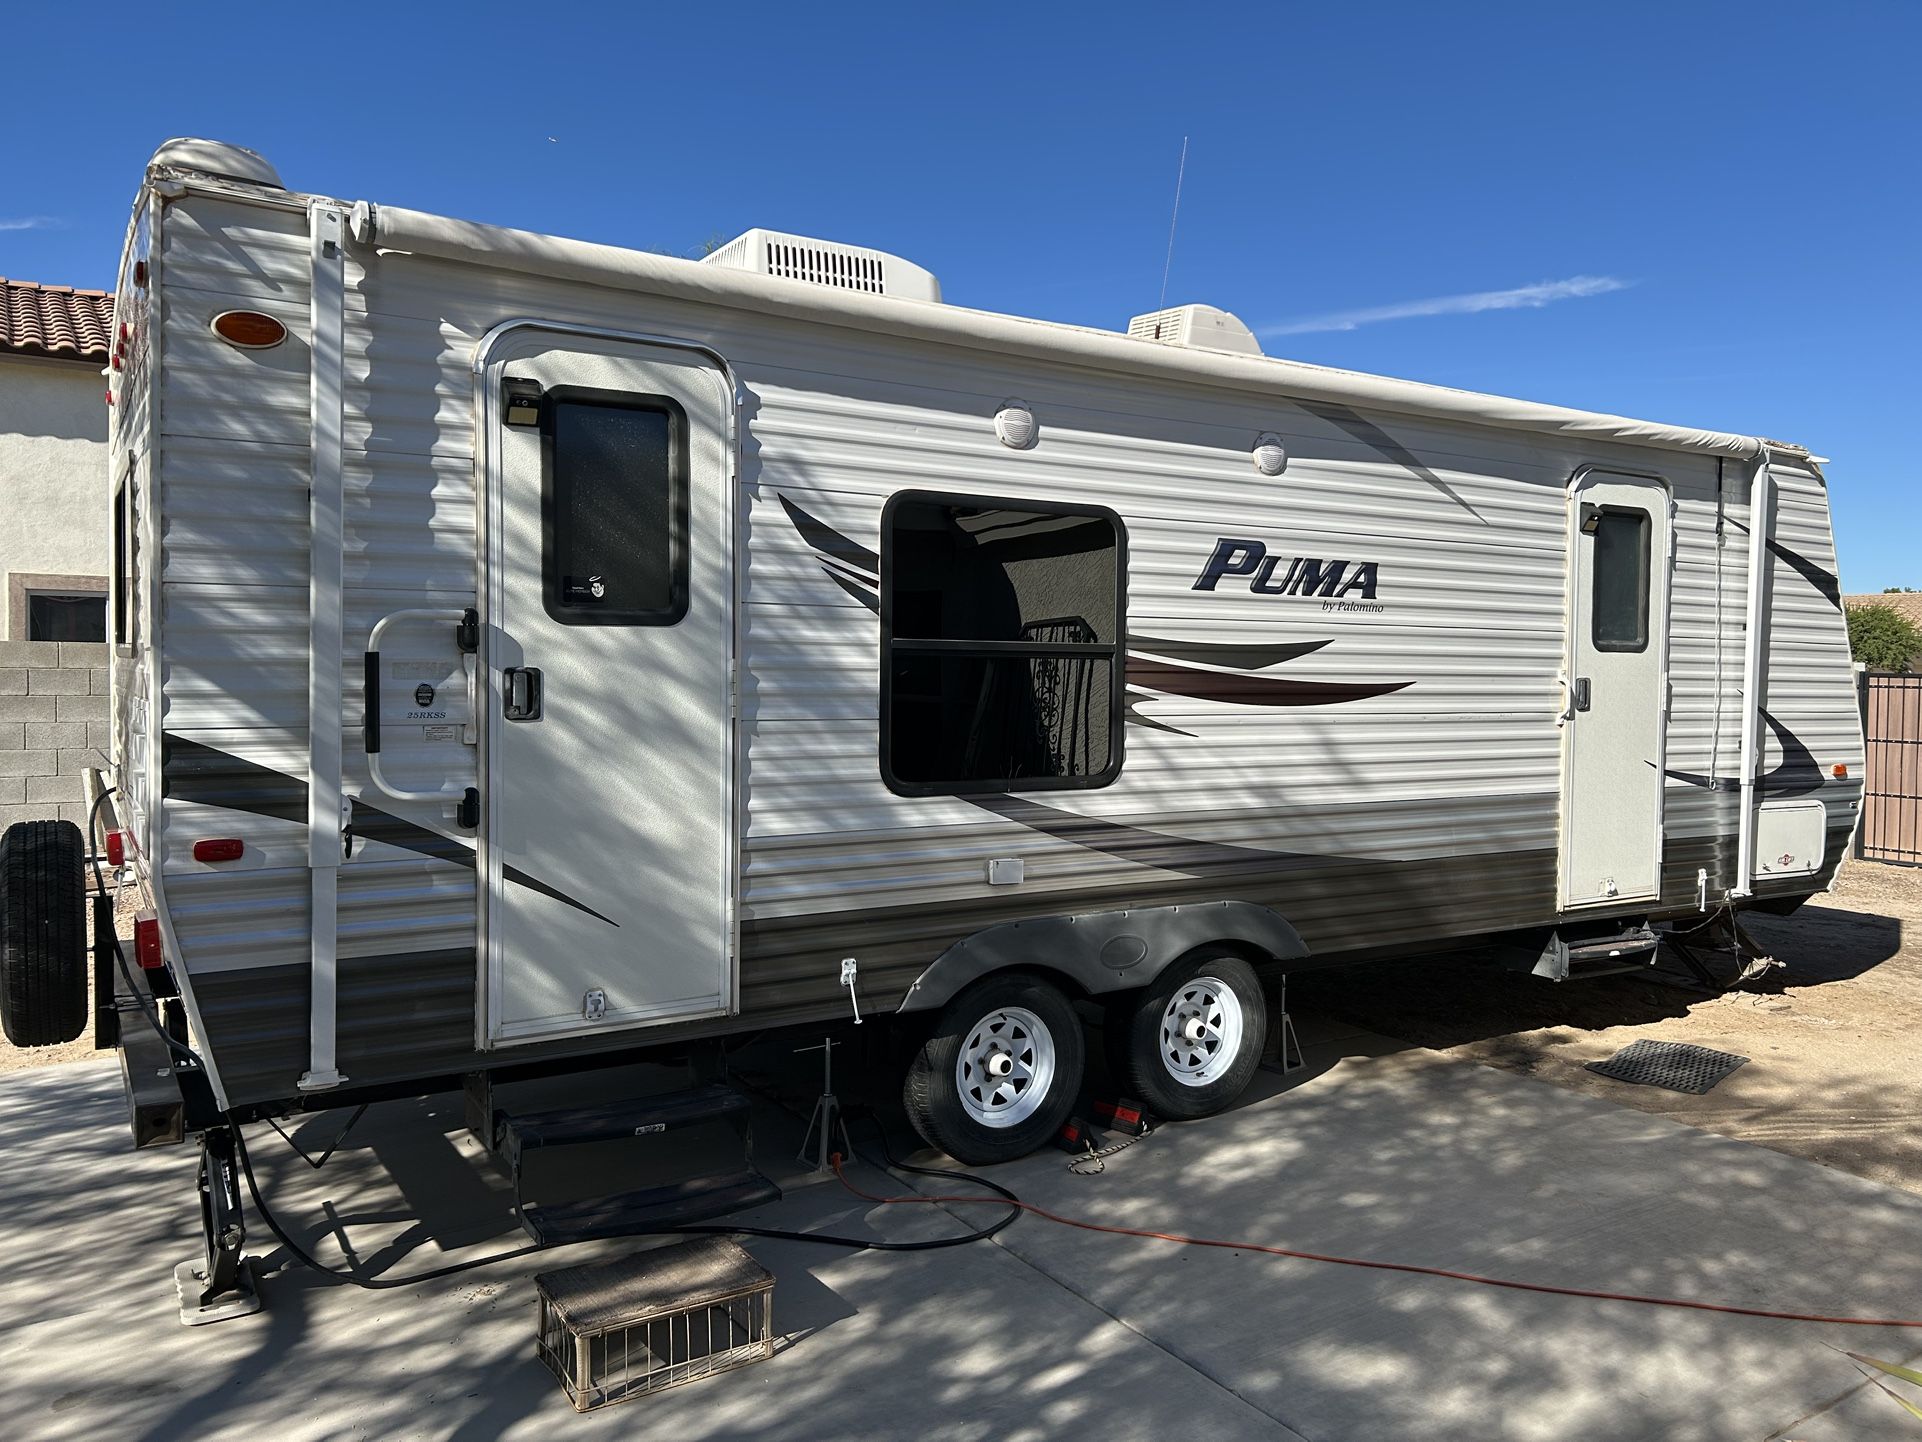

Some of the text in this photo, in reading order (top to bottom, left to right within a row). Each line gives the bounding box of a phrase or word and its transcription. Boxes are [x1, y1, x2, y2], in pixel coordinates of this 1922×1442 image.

[1191, 537, 1379, 600] PUMA
[1322, 600, 1384, 613] by Palomino
[407, 711, 447, 719] 25RKSS
